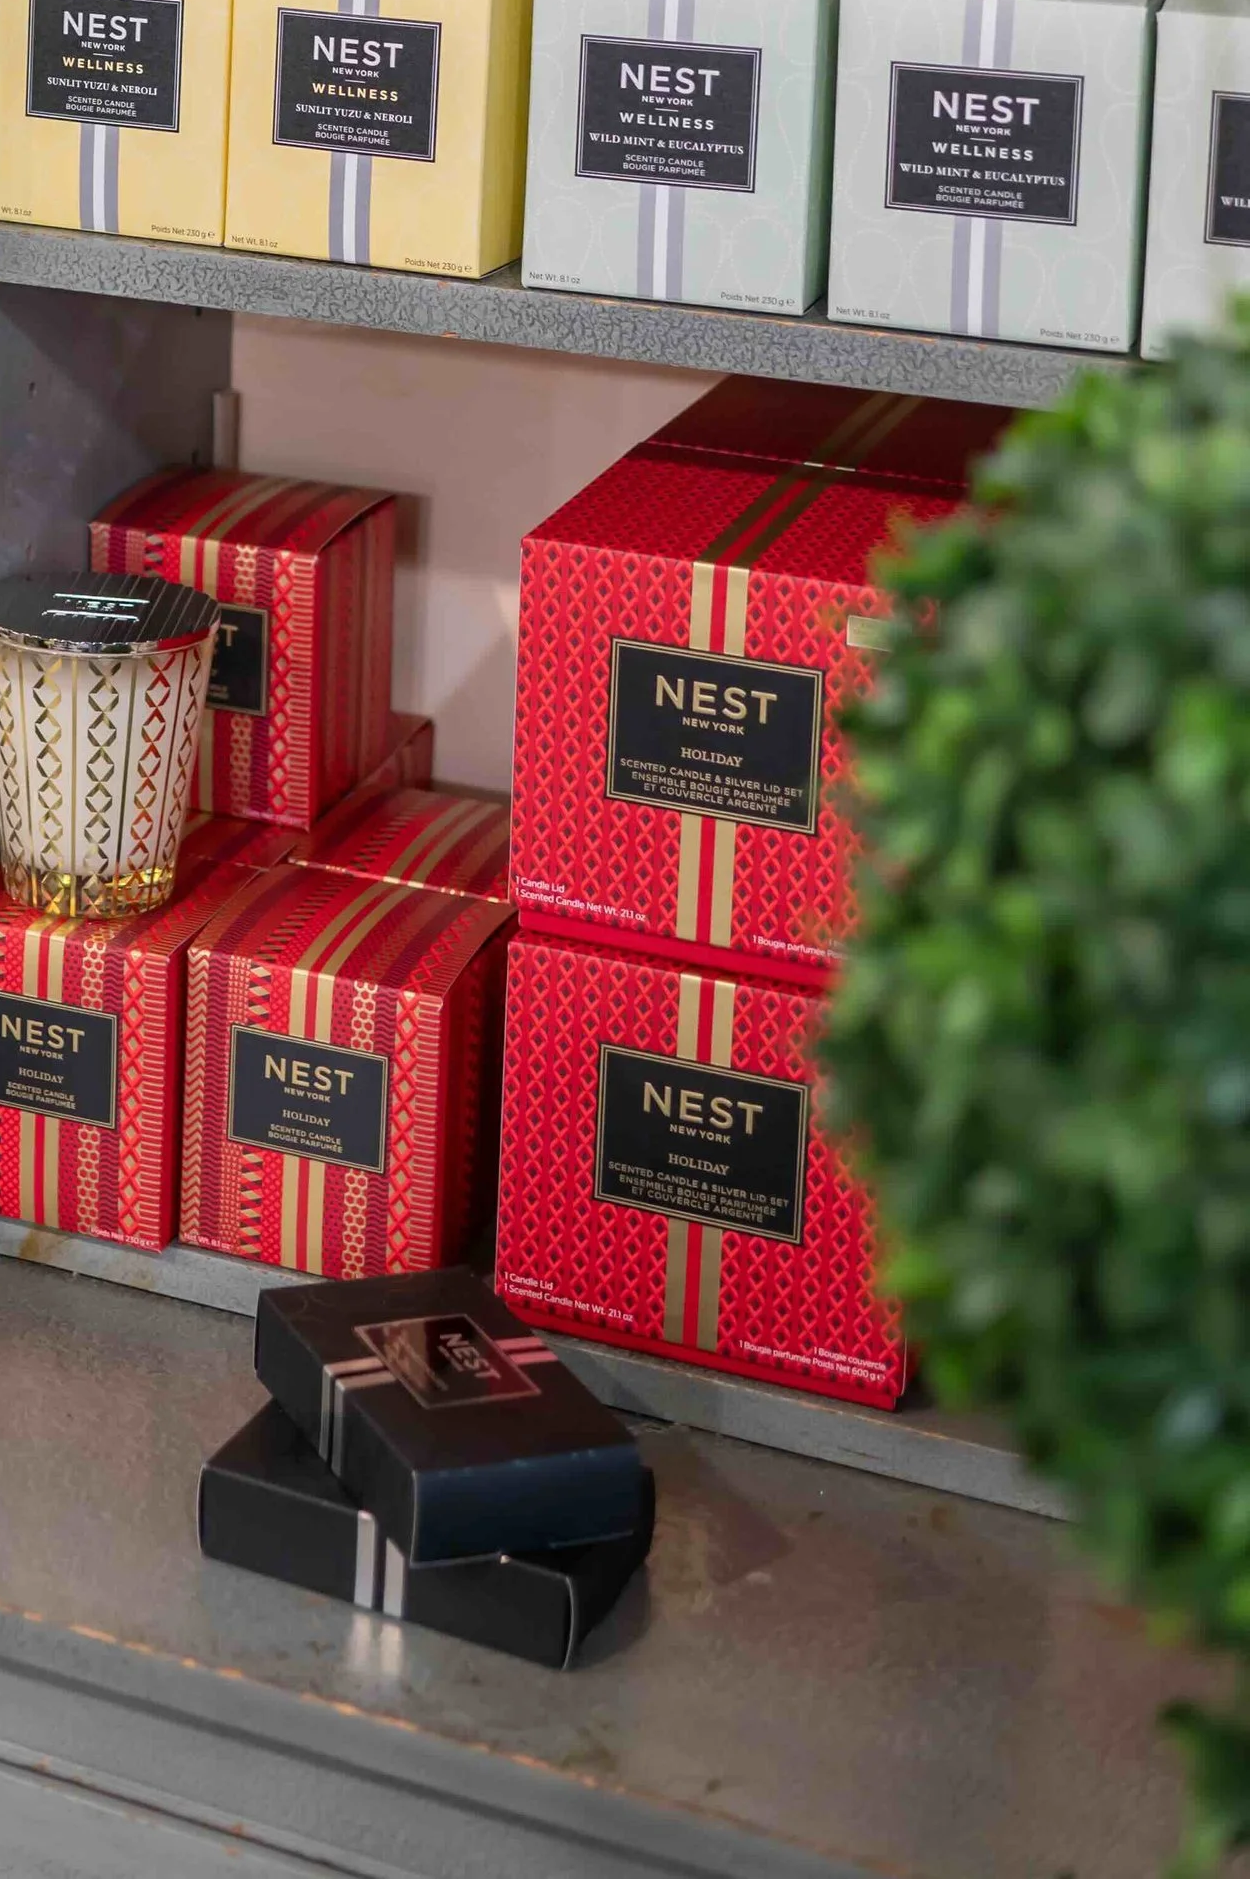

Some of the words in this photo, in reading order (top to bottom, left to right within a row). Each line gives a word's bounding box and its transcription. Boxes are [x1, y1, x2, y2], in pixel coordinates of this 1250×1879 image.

[63, 11, 148, 42] NEST
[81, 41, 100, 49] NEW
[313, 35, 403, 68] NEST
[63, 57, 144, 74] WELLNESS
[333, 67, 353, 75] NEW
[355, 70, 379, 78] YORK
[47, 77, 82, 88] SUNLIT
[83, 81, 109, 91] YUZU
[111, 84, 118, 92] &
[121, 85, 158, 95] NEROLI
[620, 63, 720, 96] NEST
[312, 83, 398, 101] WELLNESS
[642, 96, 664, 104] NEW
[667, 98, 693, 106] YORK
[66, 104, 94, 112] BOUGIE
[96, 106, 137, 117] PARFUMÉE
[68, 96, 102, 105] SCENTED
[105, 100, 135, 109] CANDLE
[933, 91, 1040, 125] NEST
[295, 103, 332, 115] SUNLIT
[334, 108, 362, 119] YUZU
[374, 112, 413, 124] NEROLI
[619, 112, 714, 130] WELLNESS
[956, 125, 980, 133] NEW
[983, 127, 1011, 136] YORK
[589, 132, 620, 143] WILD
[623, 136, 655, 148] MINT
[657, 140, 665, 148] &
[669, 140, 743, 154] EUCALYPTUS
[932, 142, 1033, 161] WELLNESS
[623, 162, 655, 171] BOUGIE
[658, 165, 706, 176] PARFUMÉE
[625, 154, 665, 164] SCENTED
[668, 157, 704, 167] CANDLE
[900, 163, 933, 175] WILD
[936, 166, 970, 178] MINT
[972, 171, 981, 179] &
[985, 171, 1065, 186] EUCALYPTUS
[231, 235, 244, 244] Net
[246, 237, 258, 245] Wt.
[405, 257, 425, 267] Poids
[426, 260, 441, 269] Net
[442, 262, 456, 271] 230
[656, 674, 778, 724] NEST
[682, 717, 710, 729] NEW
[712, 722, 745, 735] YORK
[681, 747, 743, 767] HOLIDAY
[620, 758, 667, 773] SCENTED
[670, 767, 711, 782] CANDLE
[715, 774, 721, 783] &
[725, 776, 761, 790] SILVER
[763, 783, 780, 795] LID
[784, 787, 803, 797] SET
[632, 772, 692, 788] ENSEMBLE
[690, 781, 730, 797] BOUGIE
[733, 788, 791, 807] PARFUMÉE
[644, 783, 658, 792] ET
[660, 786, 724, 804] COUVERCLE
[727, 797, 778, 814] ARGENTÉ
[1, 1014, 85, 1053] NEST
[20, 1045, 39, 1055] NEW
[41, 1049, 64, 1060] YORK
[18, 1067, 64, 1083] HOLIDAY
[265, 1055, 354, 1095] NEST
[284, 1087, 305, 1097] NEW
[307, 1091, 331, 1103] YORK
[643, 1082, 763, 1135] NEST
[282, 1110, 330, 1127] HOLIDAY
[670, 1124, 697, 1136] NEW
[700, 1130, 731, 1144] YORK
[668, 1153, 730, 1176] HOLIDAY
[439, 1332, 501, 1380] NEST
